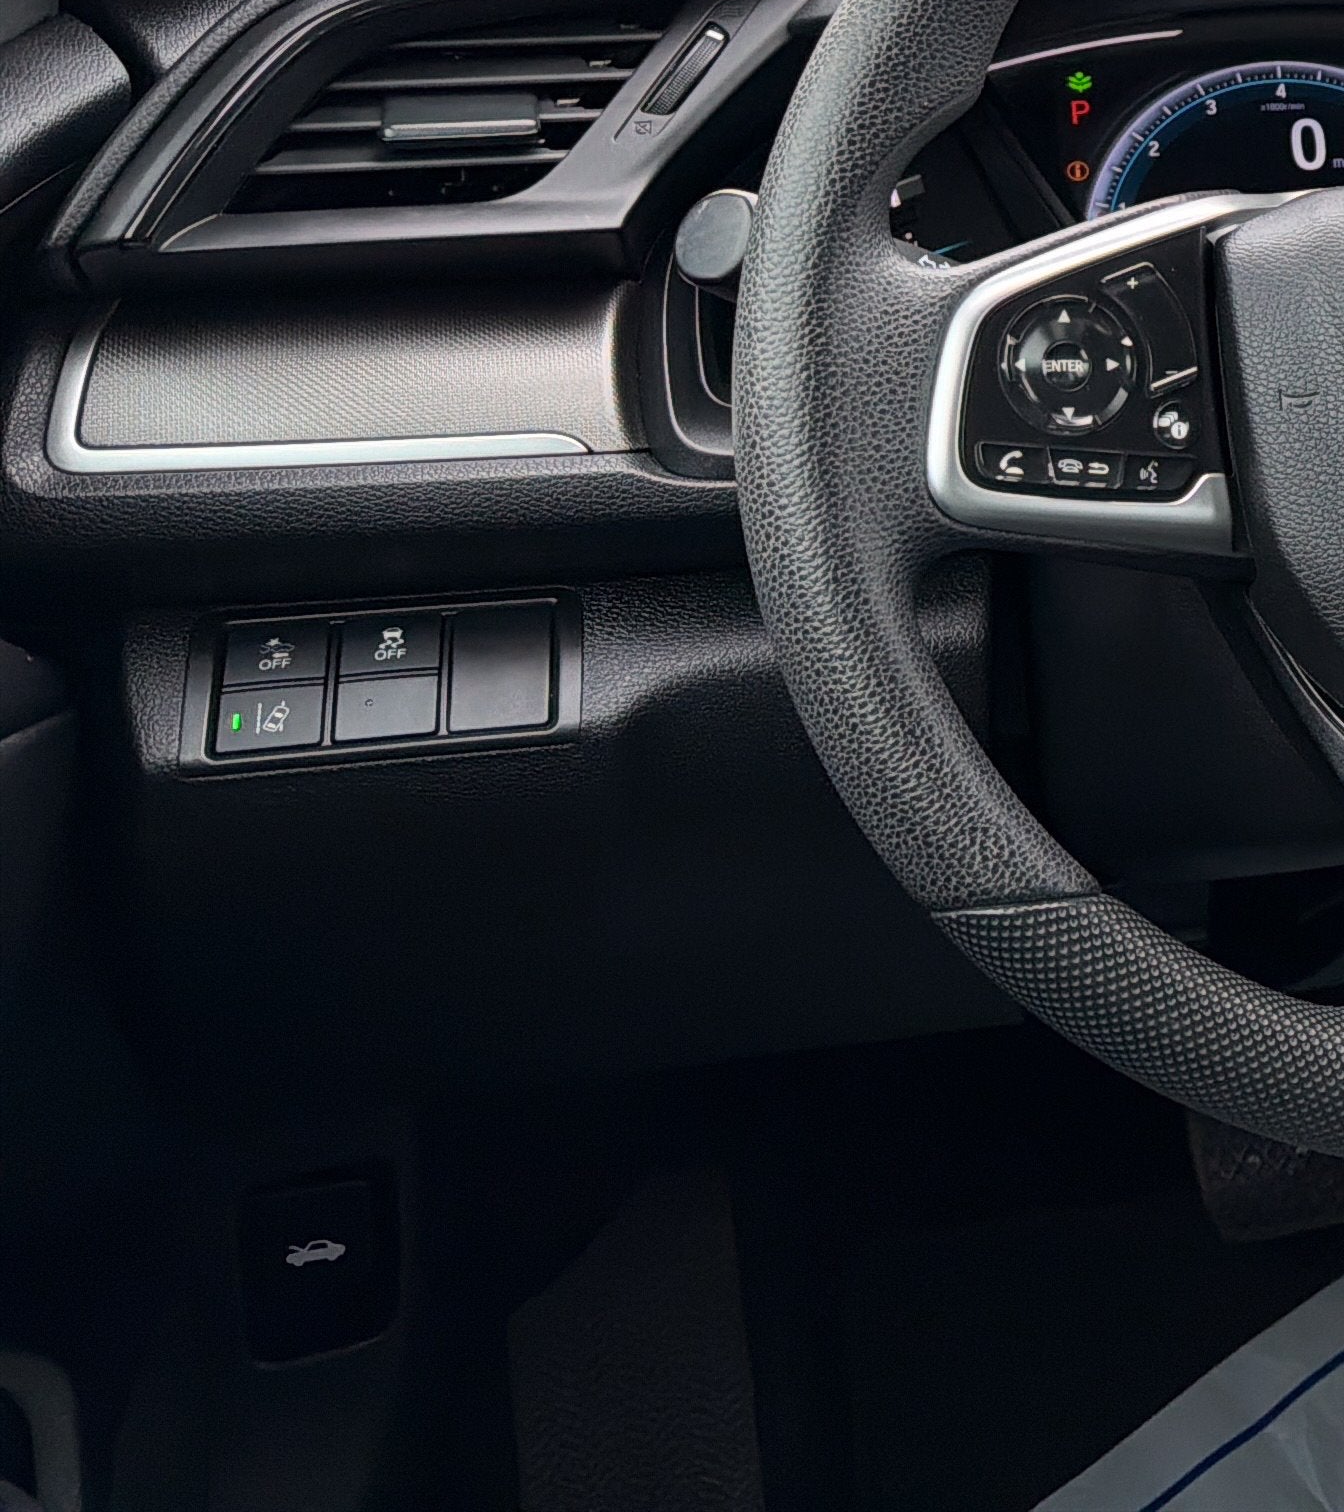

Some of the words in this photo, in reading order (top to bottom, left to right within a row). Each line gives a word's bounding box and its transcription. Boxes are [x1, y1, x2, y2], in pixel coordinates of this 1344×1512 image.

[1275, 83, 1287, 99] 4
[1071, 100, 1090, 125] P
[1205, 99, 1217, 116] 3
[1149, 140, 1161, 157] 2
[1290, 117, 1327, 172] 0
[1044, 358, 1084, 372] ENTER
[373, 647, 408, 662] OFF
[258, 657, 292, 671] OFF
